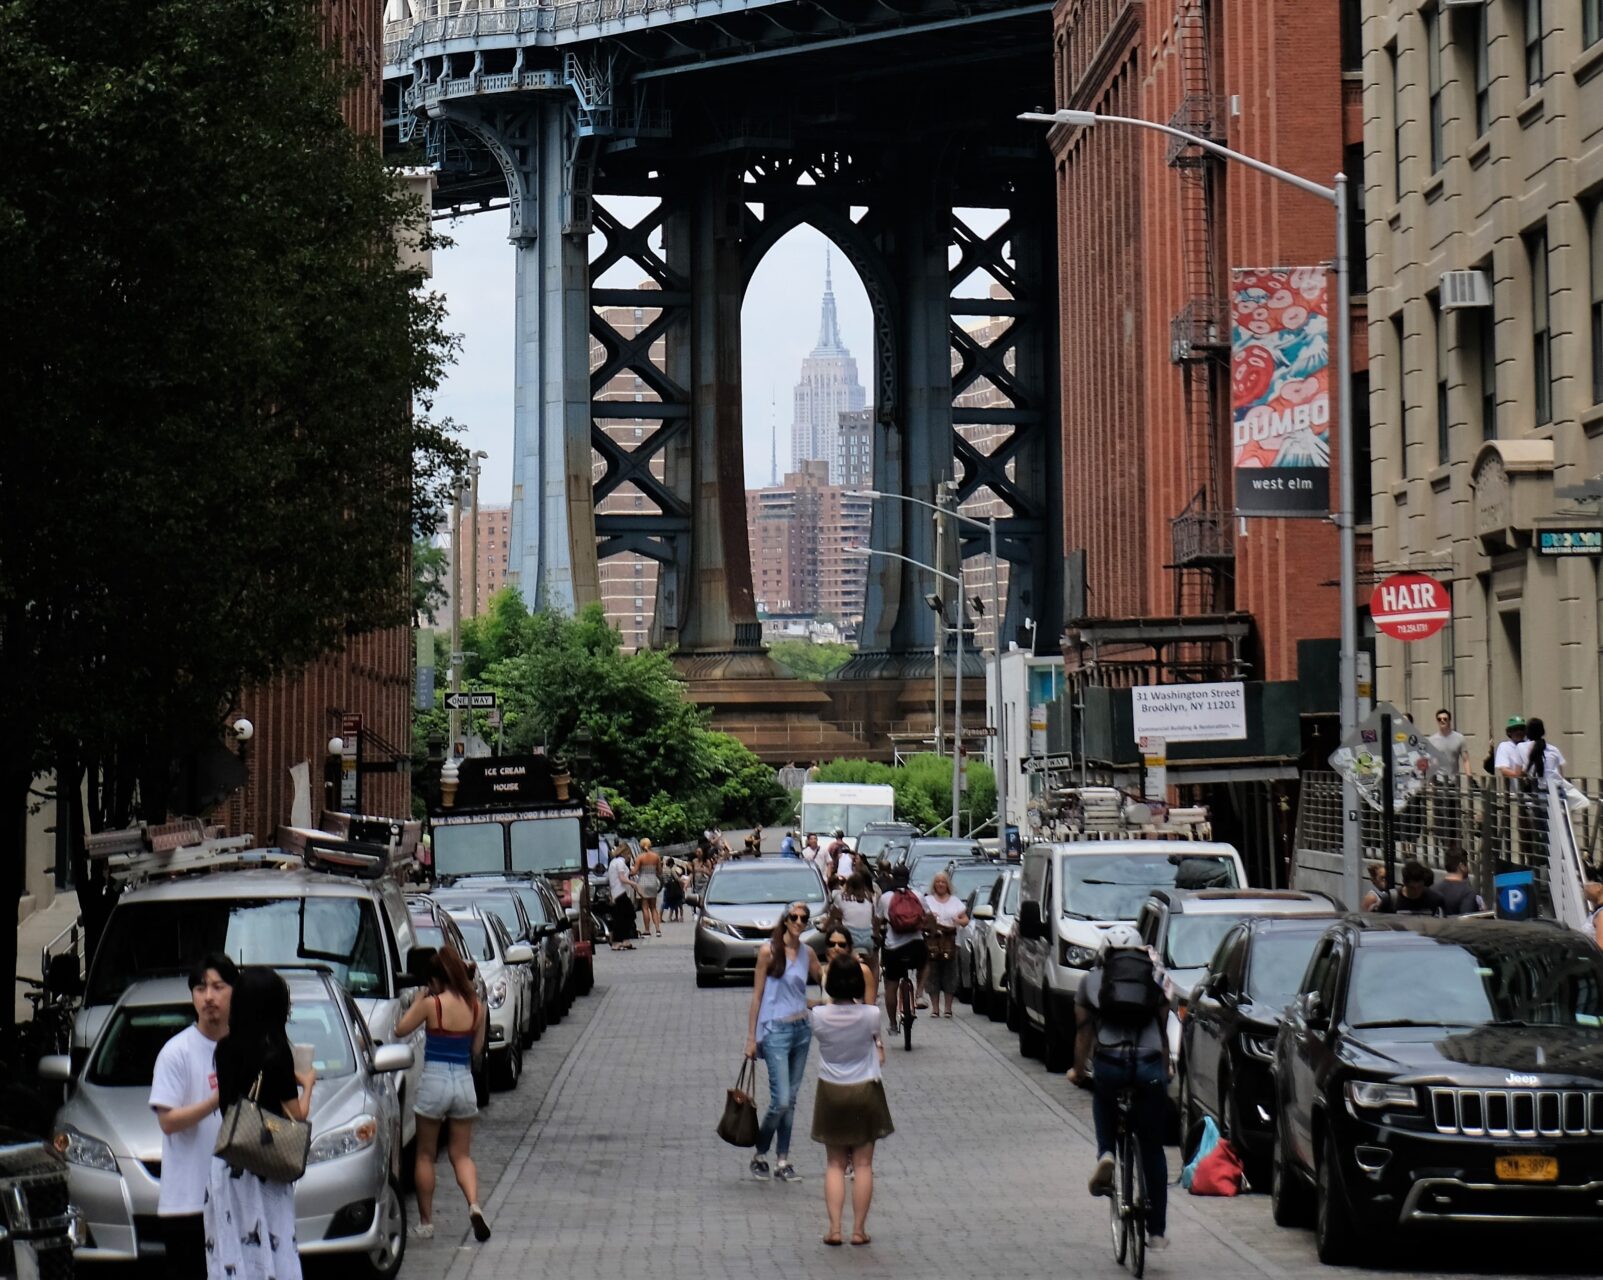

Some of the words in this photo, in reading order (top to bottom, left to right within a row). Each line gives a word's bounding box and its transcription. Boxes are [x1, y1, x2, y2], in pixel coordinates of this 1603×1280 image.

[1234, 393, 1329, 447] DUMBO
[1253, 478, 1284, 490] west
[1288, 478, 1313, 490] elm
[1541, 532, 1601, 547] BROOKLYN
[1381, 583, 1437, 612] HAIR
[473, 696, 489, 704] WAY
[1137, 693, 1148, 701] 31
[1150, 690, 1208, 701] Washington
[1210, 689, 1241, 698] Street
[1141, 703, 1188, 713] Brooklyn,
[1190, 702, 1204, 710] NY
[1207, 700, 1236, 710] 11201
[1049, 758, 1066, 767] WAY
[484, 768, 498, 776] ICE
[500, 766, 526, 775] CREAM
[493, 782, 519, 791] HOUSE
[1508, 889, 1523, 911] P
[1505, 1073, 1538, 1085] Jeep
